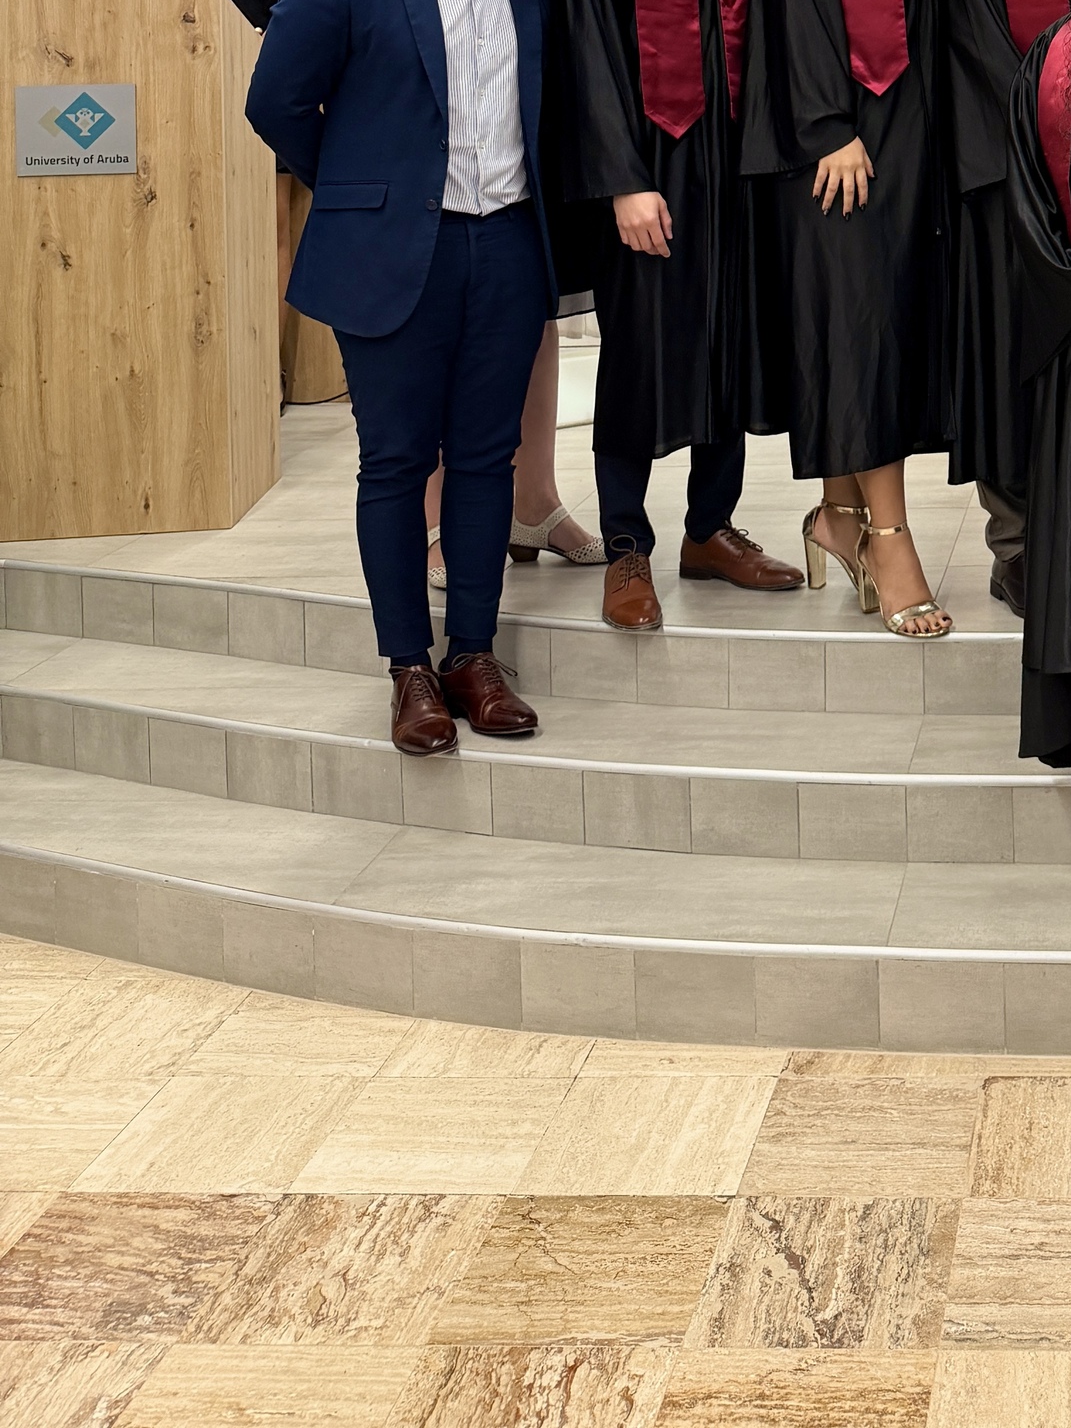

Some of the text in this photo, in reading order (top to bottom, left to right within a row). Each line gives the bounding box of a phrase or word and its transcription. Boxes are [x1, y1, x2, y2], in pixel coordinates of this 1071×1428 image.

[25, 154, 129, 167] University of Aruba
